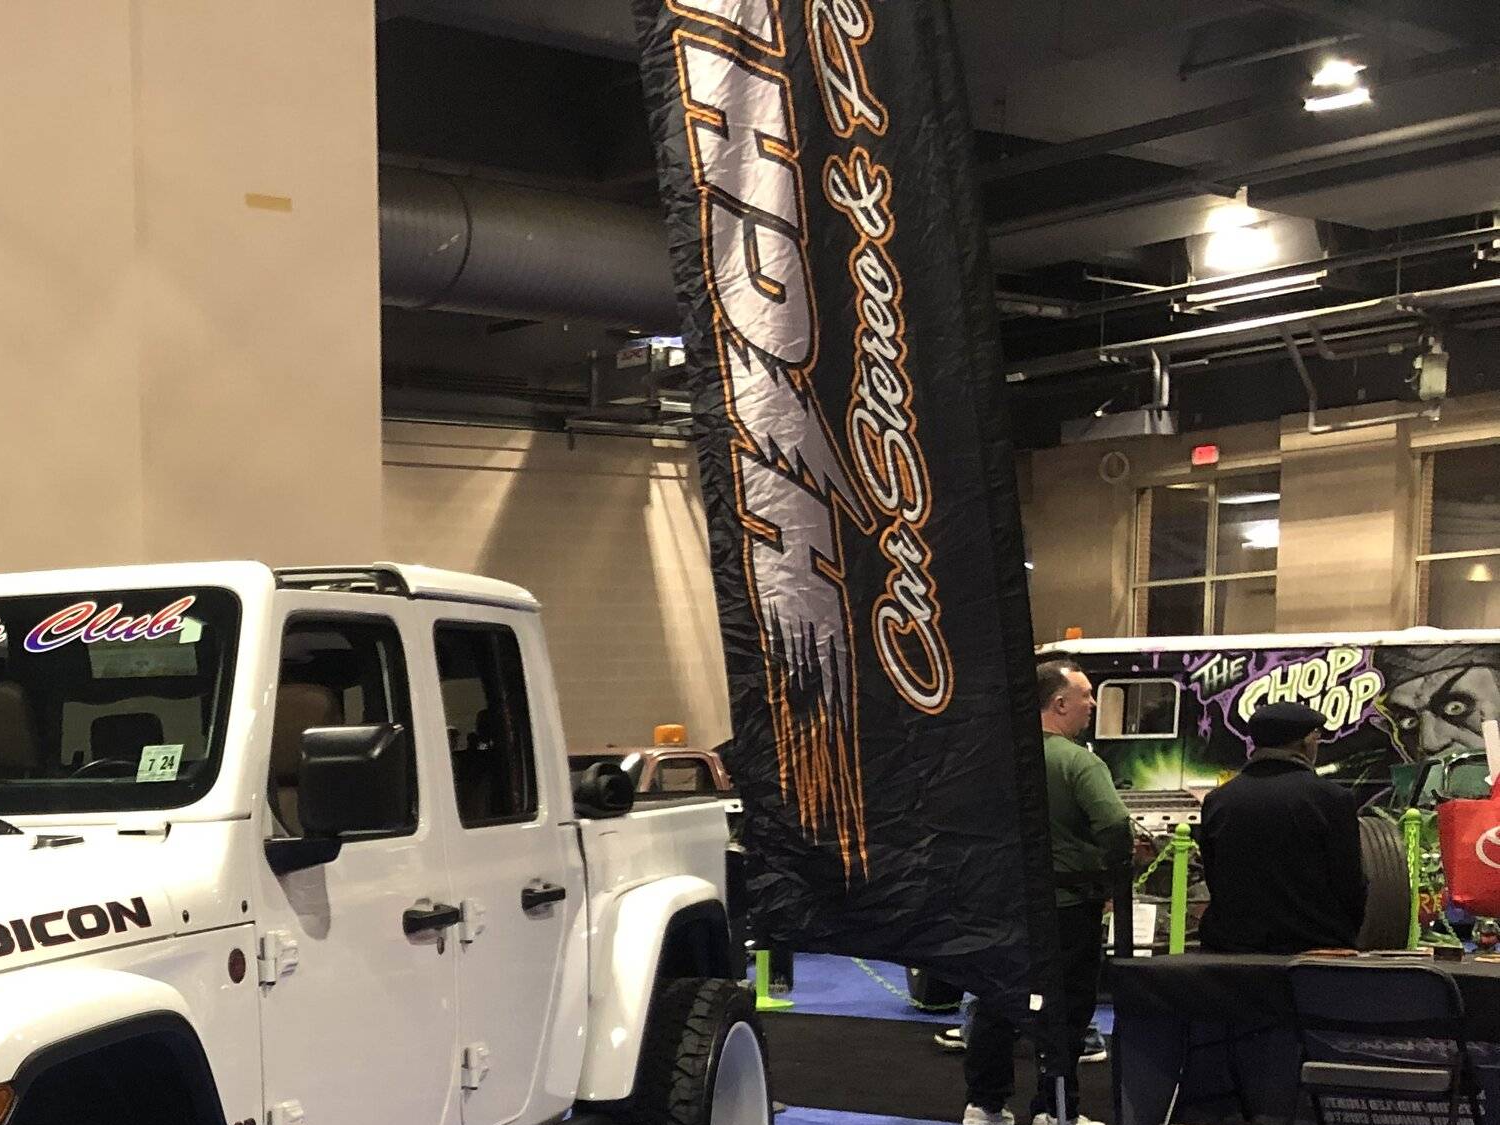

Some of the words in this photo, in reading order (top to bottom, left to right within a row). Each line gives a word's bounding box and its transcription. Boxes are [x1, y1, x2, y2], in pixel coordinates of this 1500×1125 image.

[827, 157, 888, 239] &
[673, 28, 876, 745] HIGH
[850, 246, 928, 522] Stereo
[23, 595, 197, 653] Club
[877, 527, 946, 709] Car
[1190, 653, 1247, 692] THE
[147, 758, 156, 772] 7
[160, 755, 175, 770] 24
